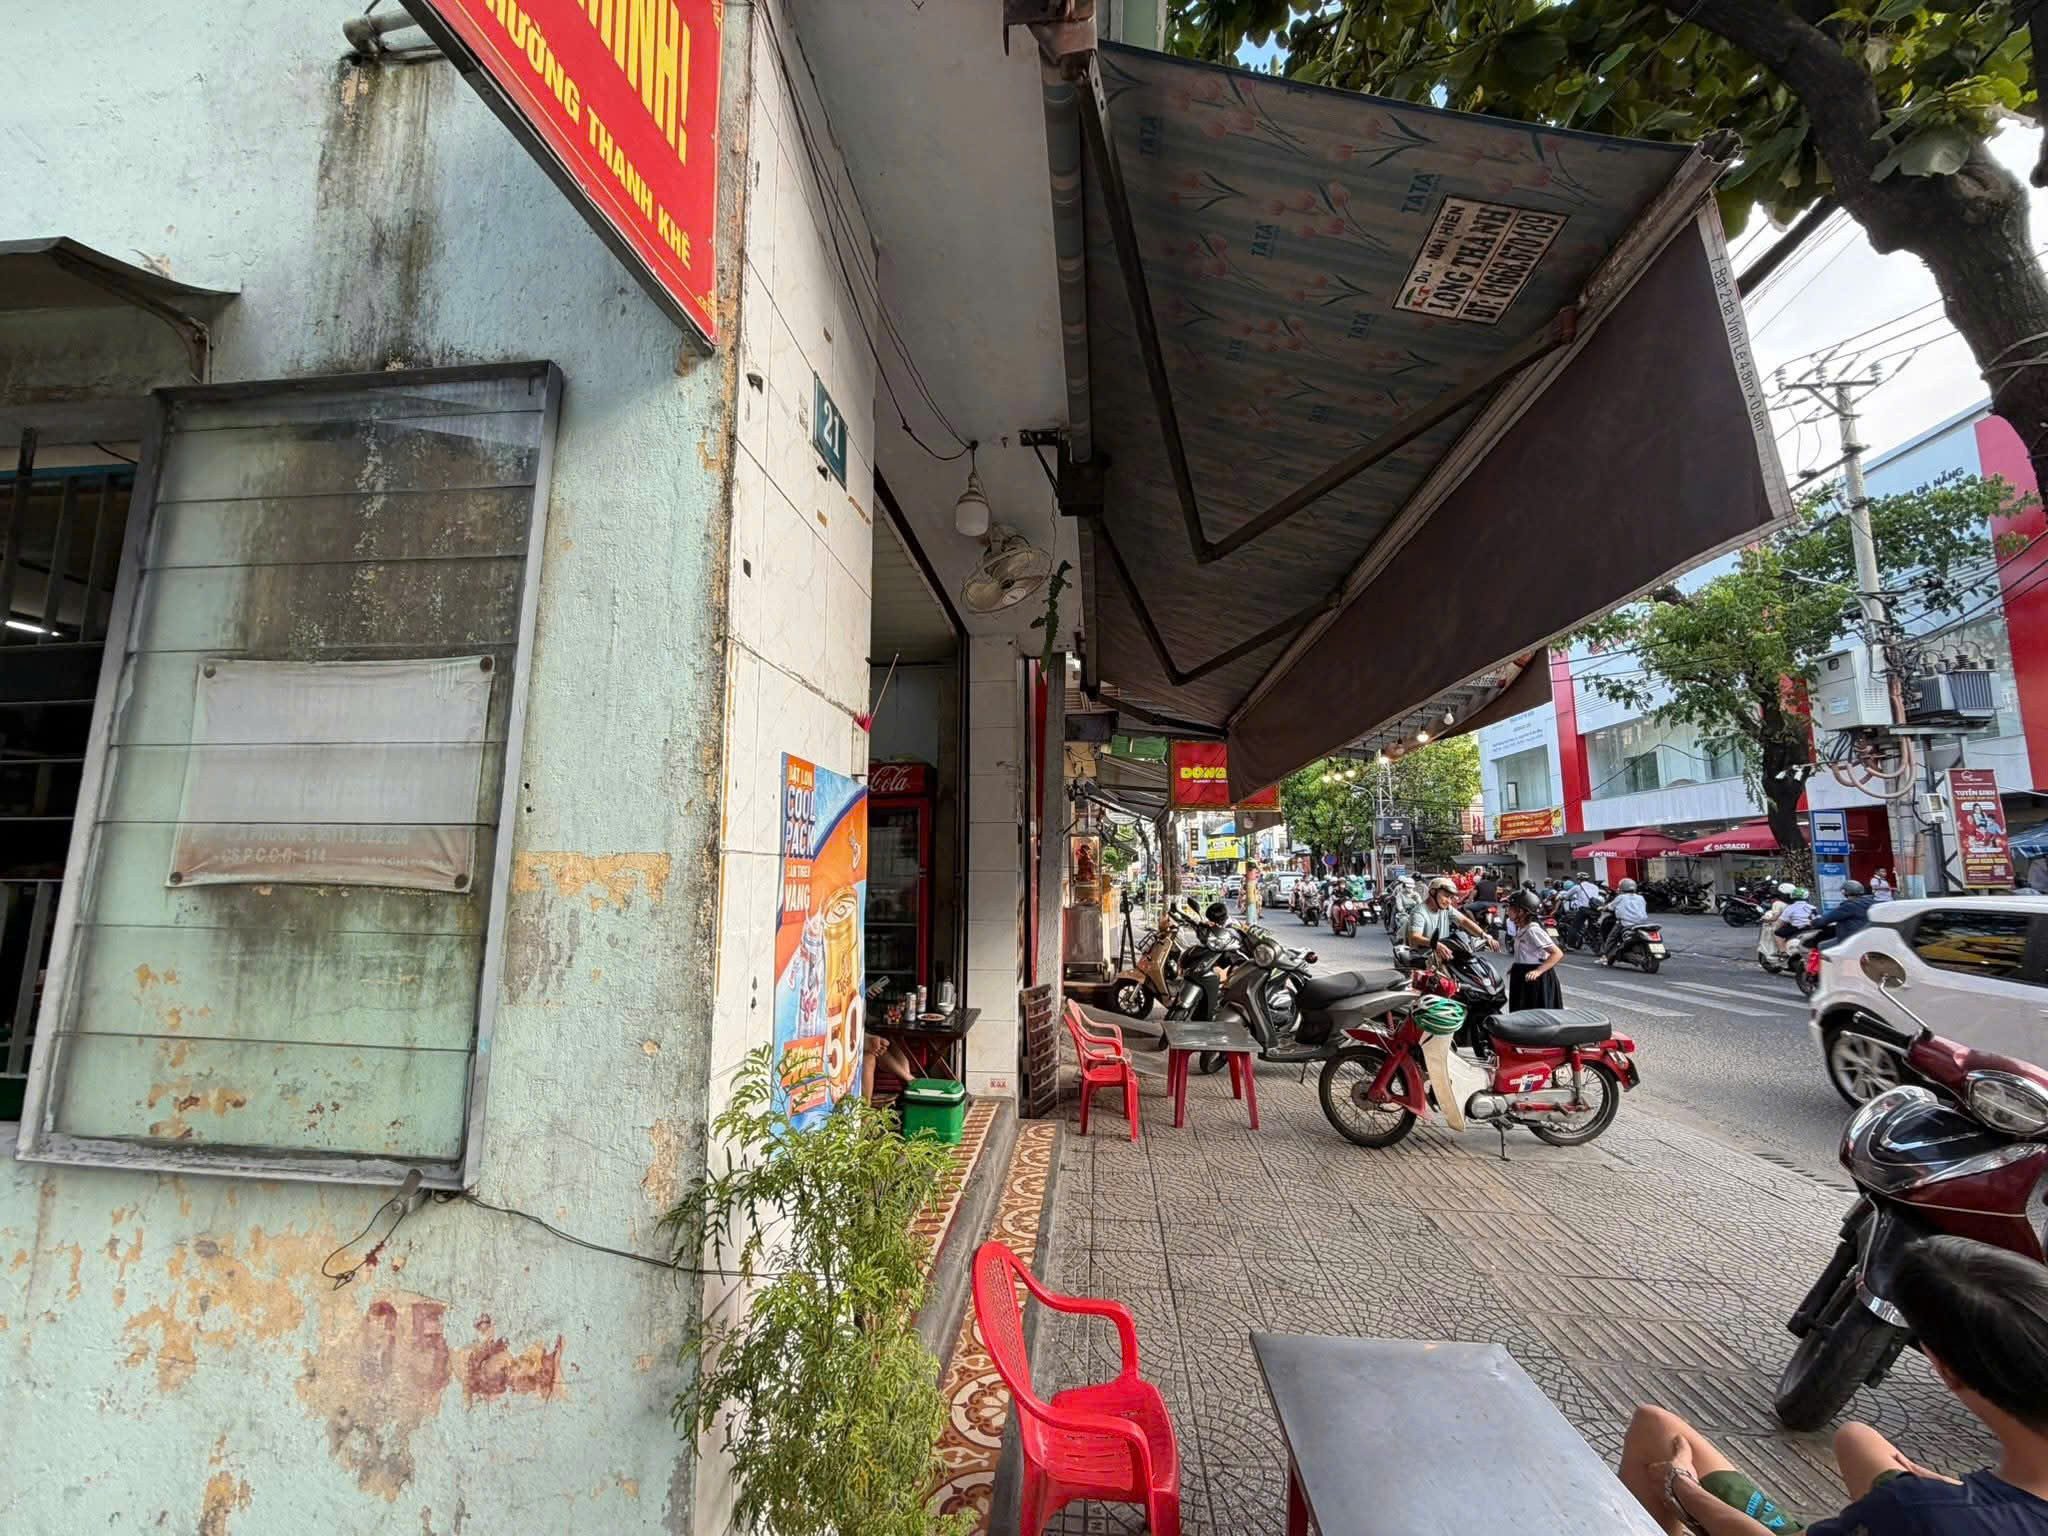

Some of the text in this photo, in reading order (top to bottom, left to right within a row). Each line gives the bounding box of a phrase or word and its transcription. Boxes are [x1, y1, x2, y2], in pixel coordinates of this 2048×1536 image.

[587, 104, 654, 222] THANH
[658, 203, 691, 271] KHÊ
[1401, 172, 1435, 214] TATA
[1427, 207, 1512, 311] LONG THÀNH
[1719, 290, 1732, 300] 2
[1738, 361, 1754, 390] 4.8m
[1748, 391, 1755, 399] x
[824, 400, 840, 459] 21
[1750, 402, 1764, 432] 0.6m
[870, 765, 912, 791] Cola
[786, 785, 816, 823] COOL
[304, 848, 328, 863] 114
[784, 820, 816, 858] PACK
[785, 880, 811, 912] VÀNG
[827, 994, 862, 1079] 50
